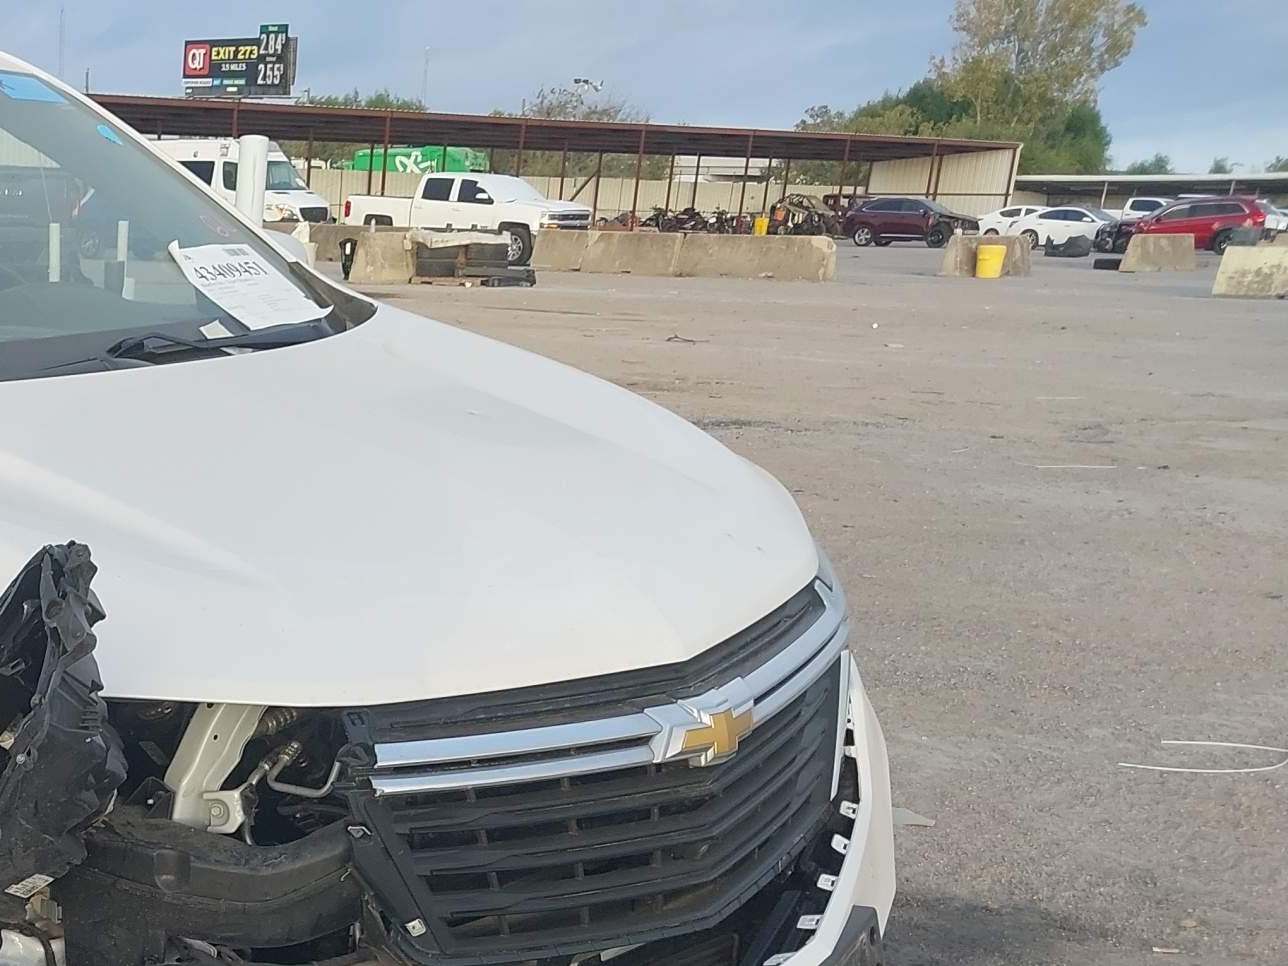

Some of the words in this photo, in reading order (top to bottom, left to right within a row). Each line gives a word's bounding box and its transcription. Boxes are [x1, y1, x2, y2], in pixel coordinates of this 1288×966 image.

[188, 48, 206, 70] QT
[212, 47, 235, 60] EXIT
[238, 46, 258, 59] 273
[193, 261, 269, 283] 43409451
